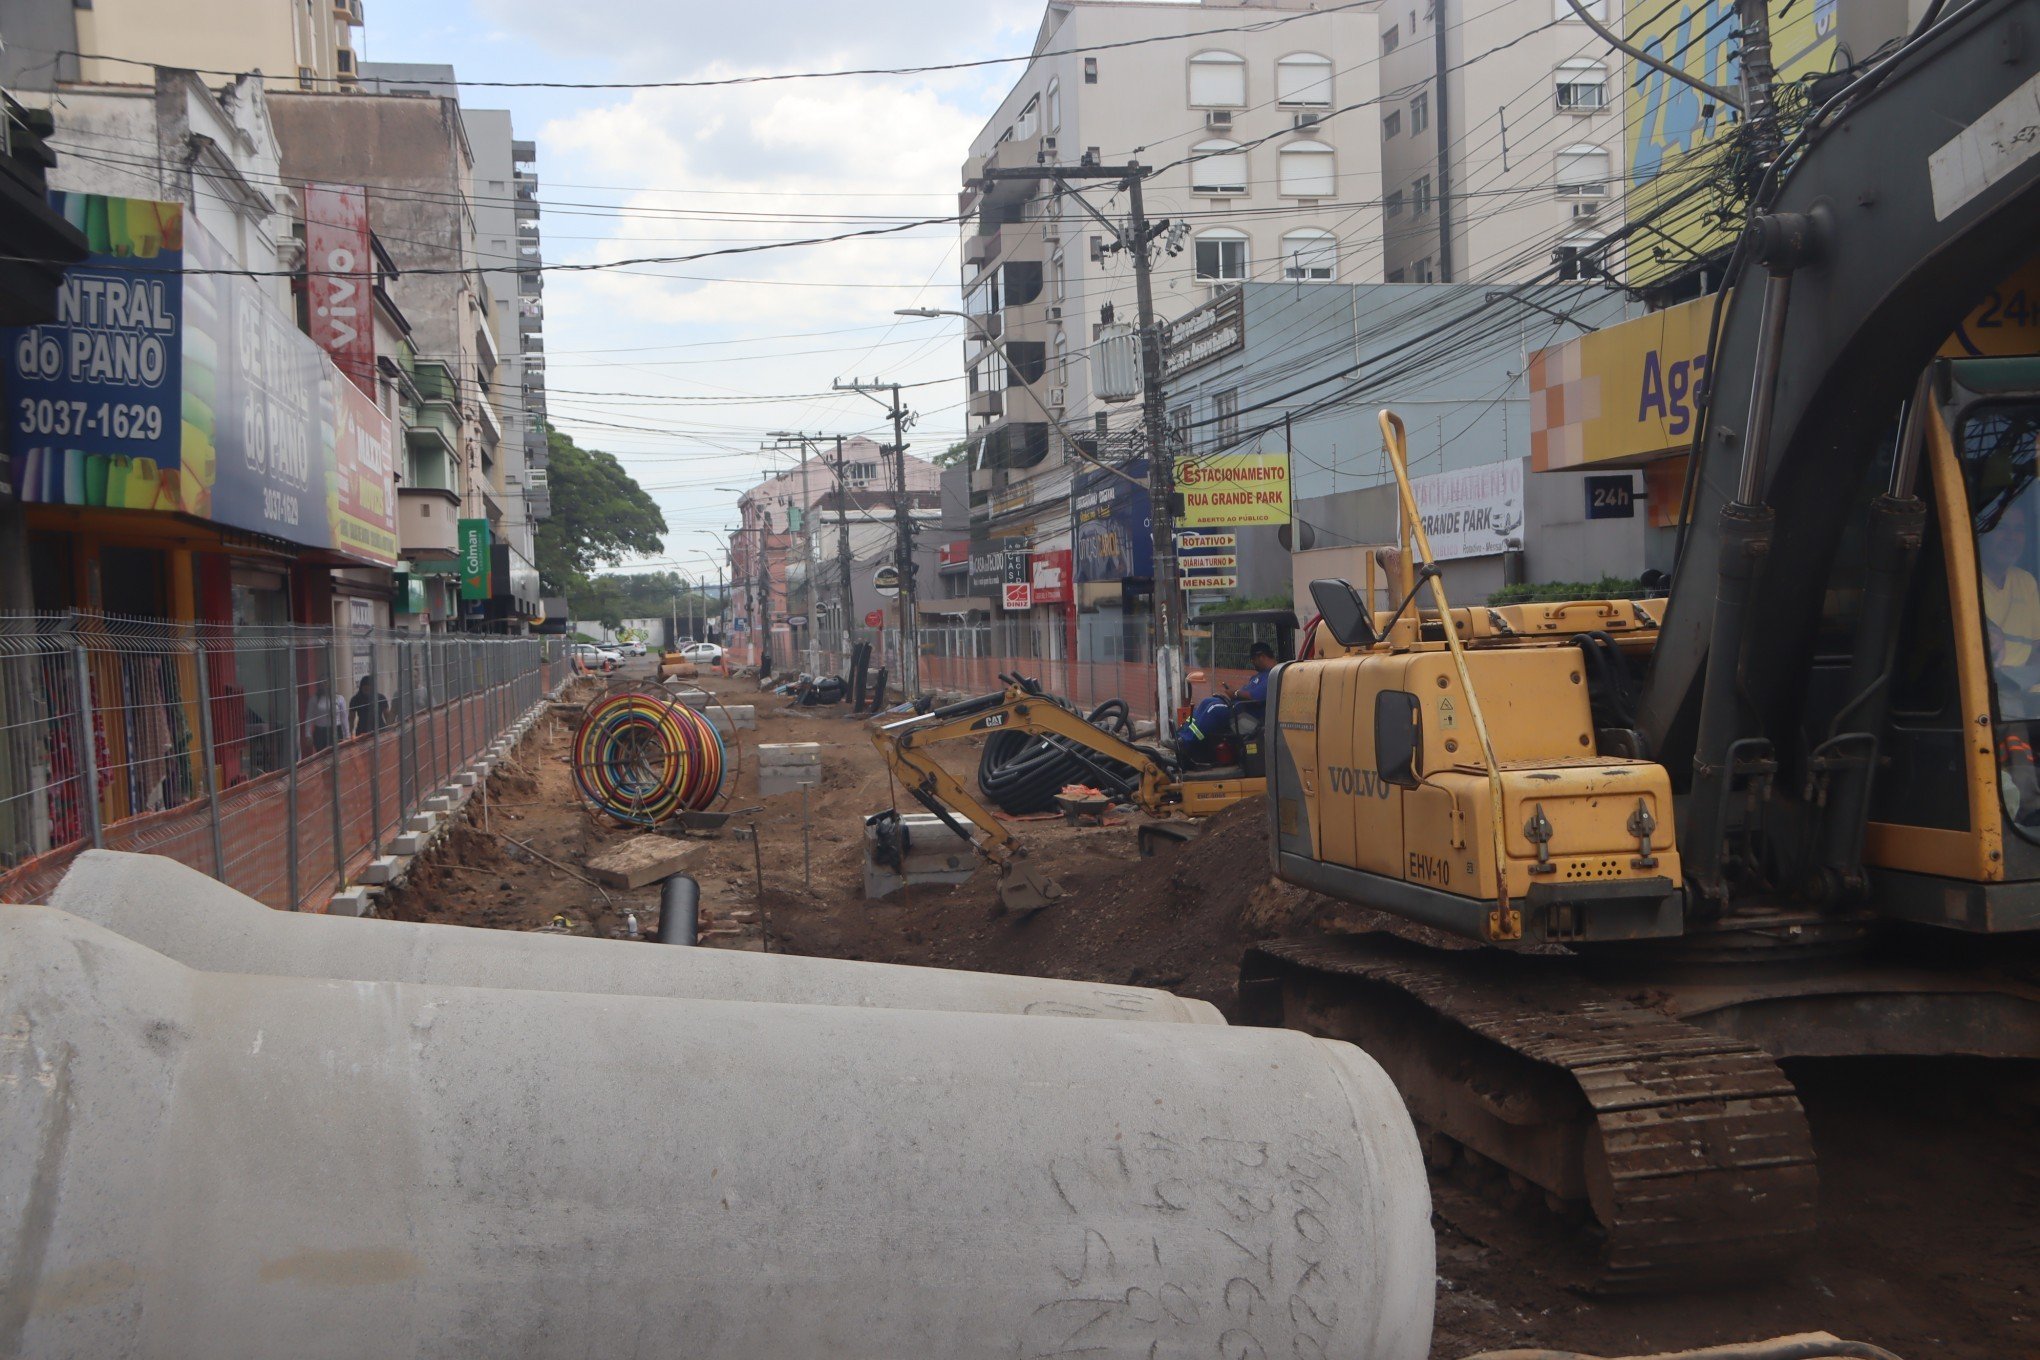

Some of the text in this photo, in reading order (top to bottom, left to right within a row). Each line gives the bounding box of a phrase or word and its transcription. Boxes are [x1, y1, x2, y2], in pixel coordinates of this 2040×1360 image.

[58, 276, 172, 330] NTRAL
[317, 248, 358, 349] vivo
[18, 329, 164, 382] do PANO
[240, 289, 310, 414] CENTRAL
[19, 398, 163, 441] 3037-1629
[245, 396, 267, 465] do
[267, 401, 308, 484] PANO
[1183, 463, 1285, 482] ESTACIONAMENTO
[1187, 490, 1283, 506] RUA GRANDE PARK
[1593, 487, 1629, 507] 24h
[1238, 513, 1269, 522] PÚBLICO
[1421, 510, 1461, 537] GRANDE
[1462, 506, 1493, 532] PARK
[467, 529, 479, 574] Colman
[1182, 536, 1226, 547] ROTATIVO
[1183, 578, 1227, 587] MENSAL
[985, 714, 1003, 727] CAT
[1328, 765, 1390, 800] VOLVO
[1410, 851, 1450, 886] EHV-10
